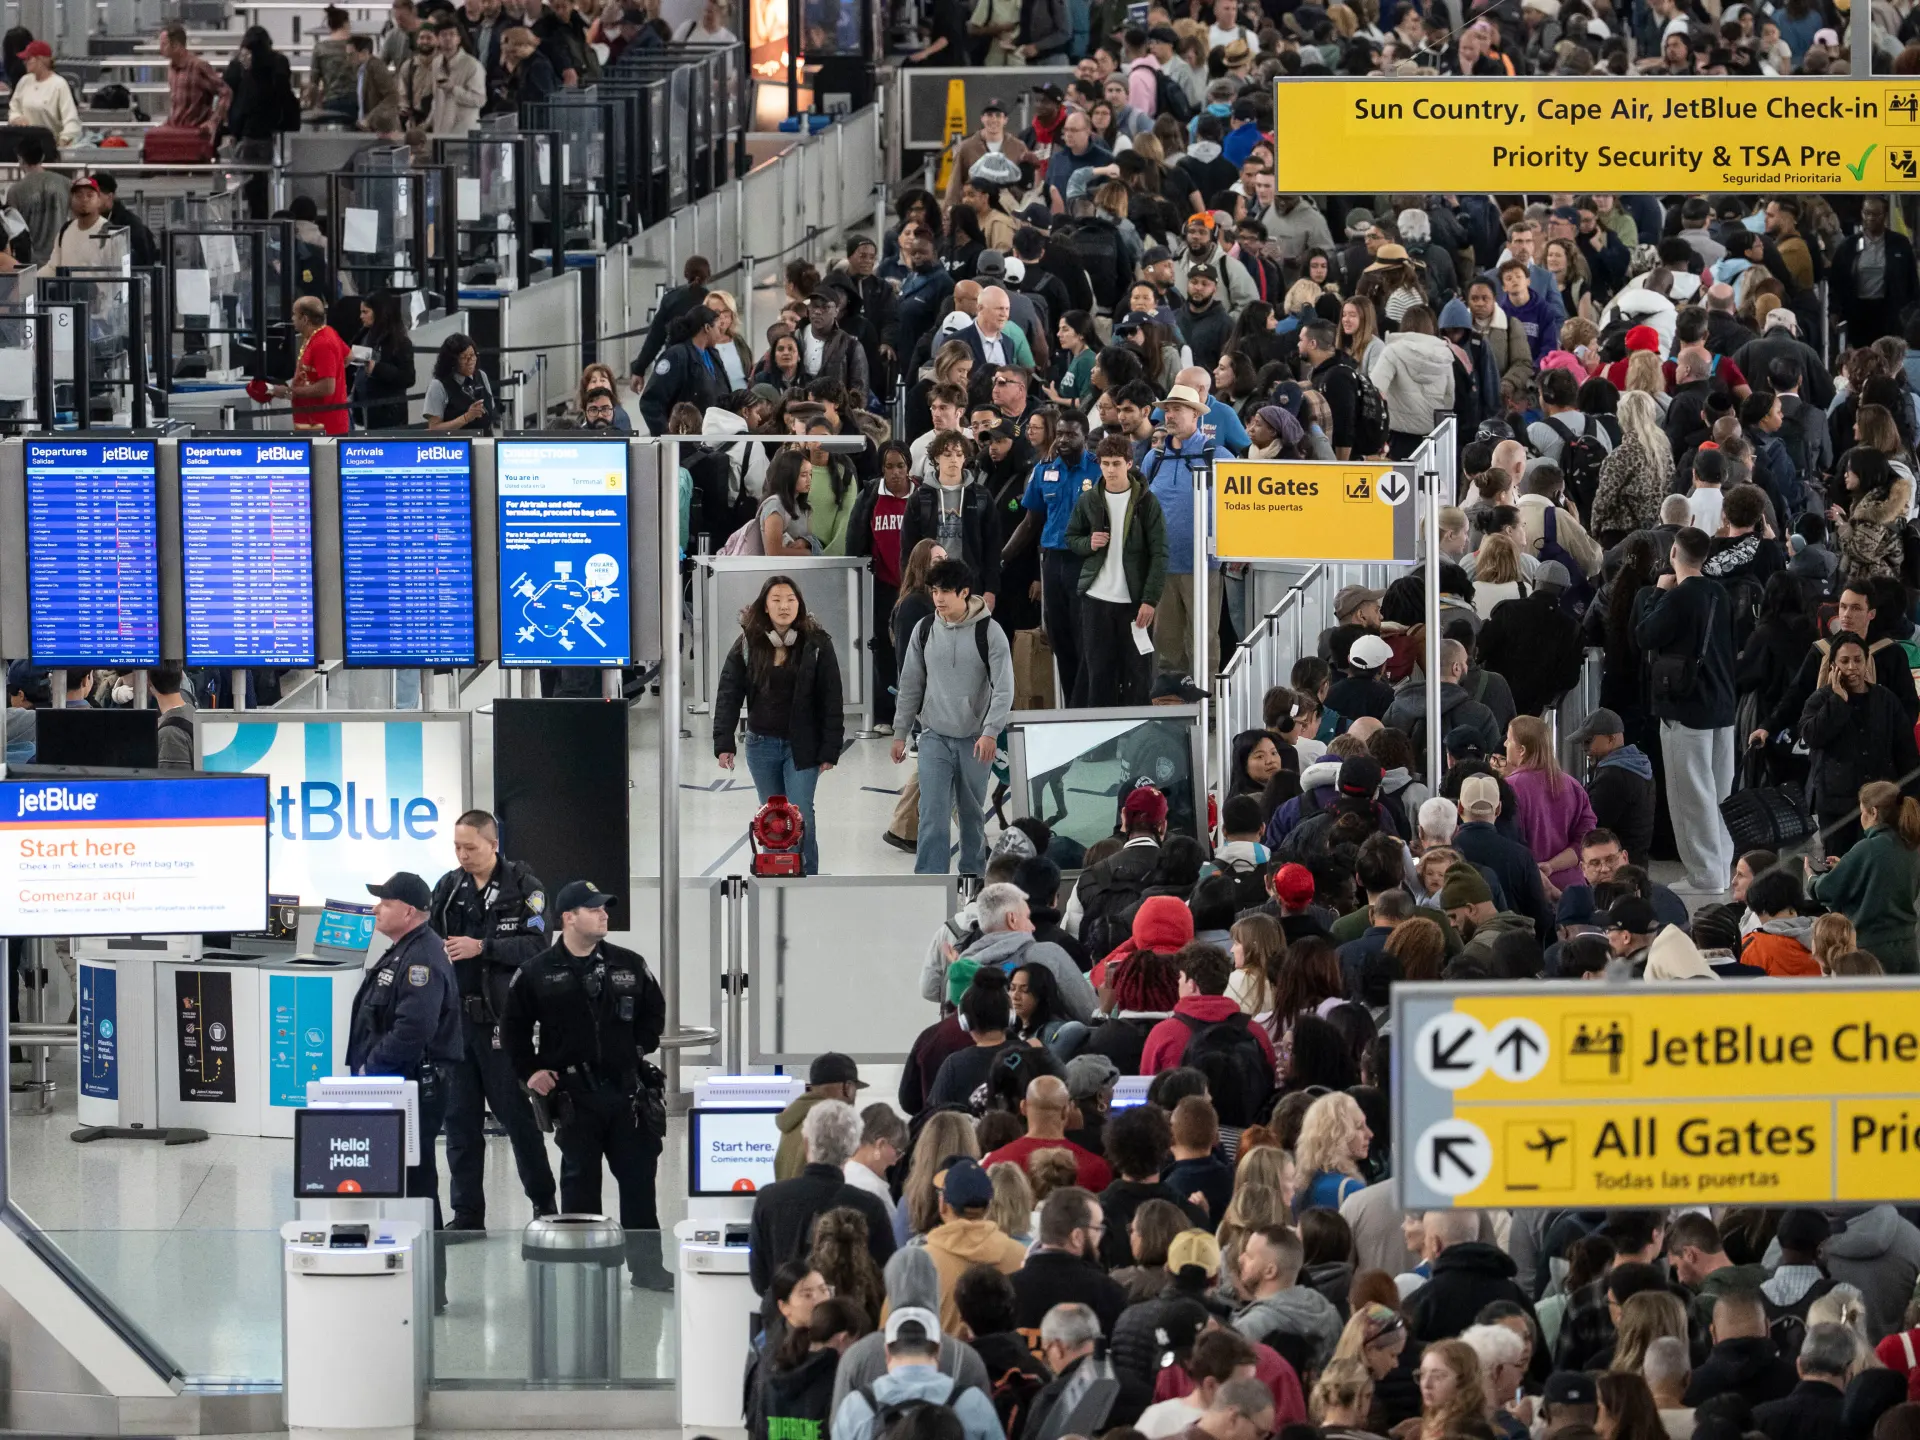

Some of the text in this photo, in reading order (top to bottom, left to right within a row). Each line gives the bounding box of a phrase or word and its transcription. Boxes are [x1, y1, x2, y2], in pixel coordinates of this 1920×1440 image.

[1355, 96, 1878, 125] Sun Country, Cape Air, JetBlue Check-in
[1493, 145, 1841, 172] Priority Security & TSA Pre
[1722, 173, 1841, 186] Seguridad Prioritaria
[113, 290, 123, 304] 4
[31, 446, 148, 463] Departures jetBlue
[186, 446, 303, 463] Departures jetBlue
[345, 446, 463, 463] Arrivals jetBlue
[346, 458, 375, 466] Llegadas
[610, 476, 617, 487] 5
[1223, 475, 1319, 496] All Gates
[543, 509, 572, 517] proceed
[581, 509, 595, 517] bag
[1224, 501, 1304, 512] Todas las puertas
[875, 514, 904, 531] HARV
[17, 787, 97, 817] jetBlue
[270, 781, 439, 841] tBlue
[20, 838, 136, 858] Start here
[67, 860, 98, 870] Select
[99, 861, 124, 869] seats
[130, 860, 152, 869] Print
[154, 860, 172, 870] bag
[174, 860, 195, 870] tags
[19, 889, 98, 903] Comenzar
[611, 974, 636, 982] POLICE
[1642, 1024, 1814, 1067] JetBlue
[330, 1137, 370, 1151] Hello!
[1592, 1116, 1657, 1159] All
[1677, 1117, 1816, 1157] Gates
[712, 1140, 775, 1152] Start here.
[329, 1154, 370, 1170] ¡Hola!
[711, 1155, 754, 1163] Comience
[305, 1182, 325, 1191] jetBlue
[1593, 1168, 1780, 1191] Todas las puertas
